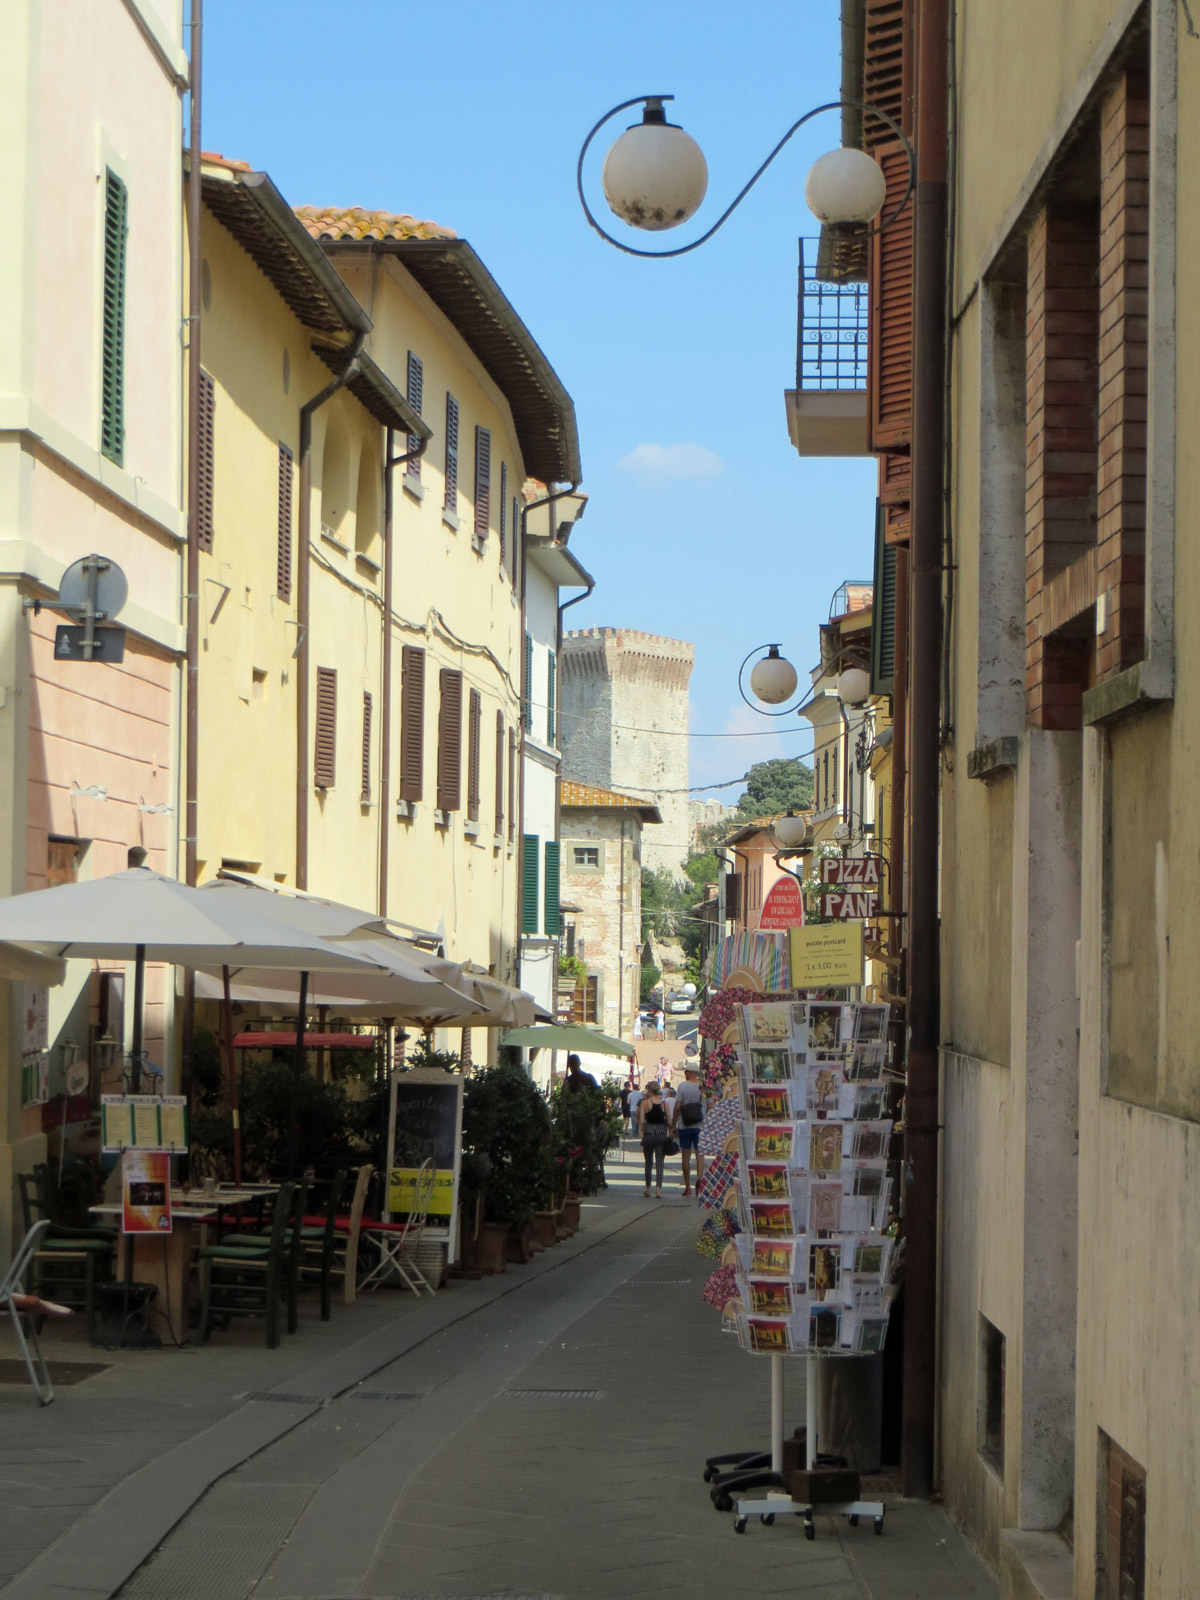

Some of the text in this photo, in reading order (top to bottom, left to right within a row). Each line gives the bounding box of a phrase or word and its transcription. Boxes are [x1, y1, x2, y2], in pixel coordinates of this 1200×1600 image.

[823, 860, 878, 883] PIZZA
[823, 938, 846, 946] postcard
[807, 963, 811, 971] 1
[817, 962, 832, 970] 3,00
